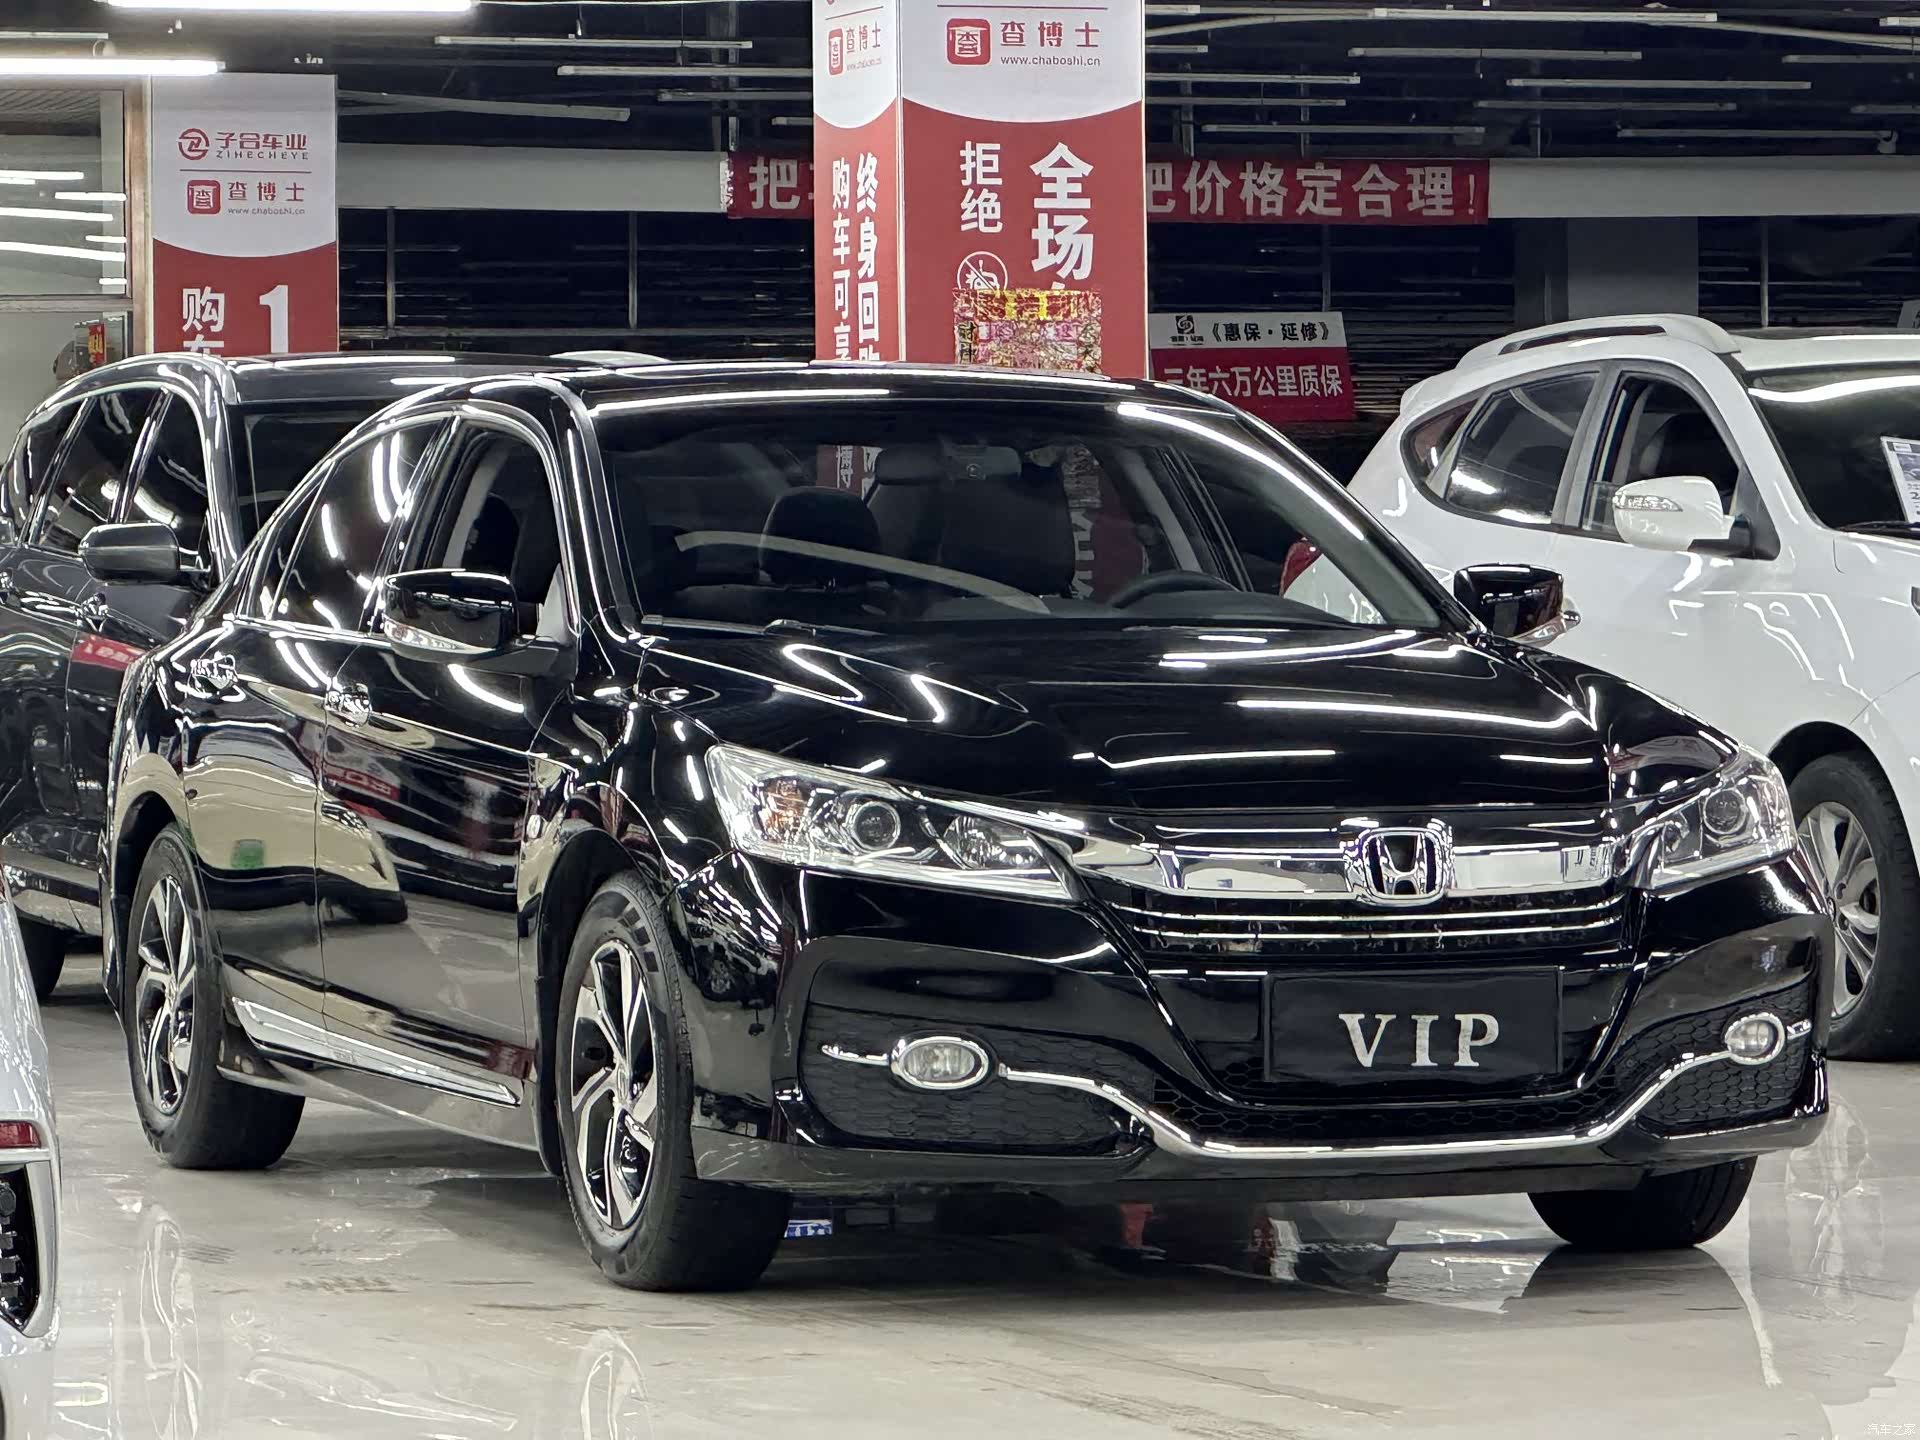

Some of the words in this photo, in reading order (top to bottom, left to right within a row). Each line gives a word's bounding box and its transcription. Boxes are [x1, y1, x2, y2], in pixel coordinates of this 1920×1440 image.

[846, 21, 881, 54] 查博士
[1000, 21, 1099, 47] 查博士
[1001, 55, 1100, 67] www.chaboshi.cn
[215, 131, 307, 150] 子合车业
[216, 150, 308, 160] ZIHECHEYE
[227, 181, 305, 202] 查博士
[959, 140, 1003, 233] 拒绝
[856, 152, 880, 361] 终身回
[1163, 364, 1344, 398] 三年六万公里质保
[1338, 1013, 1500, 1068] VIP
